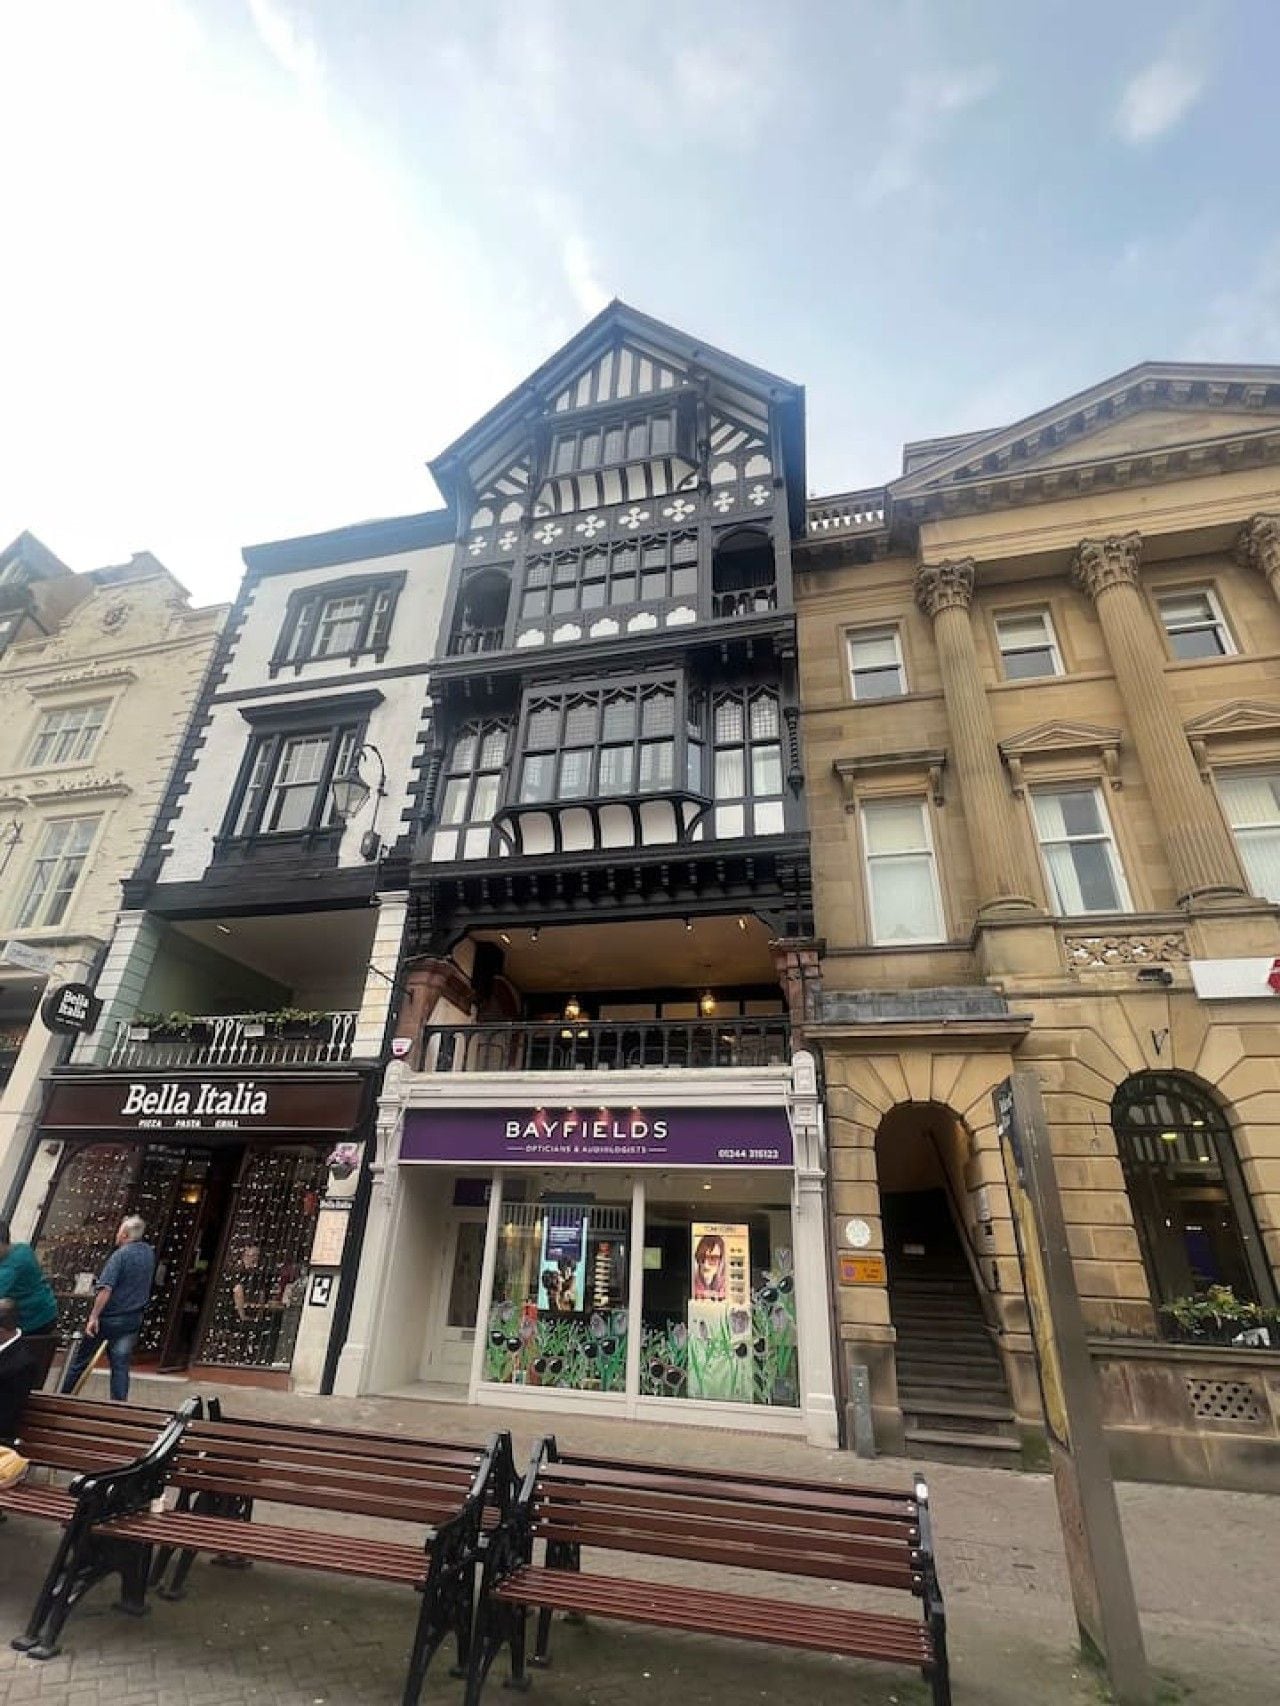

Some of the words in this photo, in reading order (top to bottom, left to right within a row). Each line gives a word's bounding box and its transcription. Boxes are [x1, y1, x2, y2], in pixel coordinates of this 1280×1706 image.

[63, 989, 90, 1008] Bella
[58, 1001, 87, 1019] Italia
[121, 1083, 191, 1115] Bella
[192, 1081, 268, 1115] Italia
[138, 1118, 163, 1128] PIZZA
[175, 1118, 201, 1128] PASTA
[214, 1118, 239, 1128] GRILL
[506, 1120, 668, 1139] BAYFIELDS
[525, 1145, 571, 1153] OPTICIANS
[582, 1145, 647, 1154] AUDIOLOGISTS
